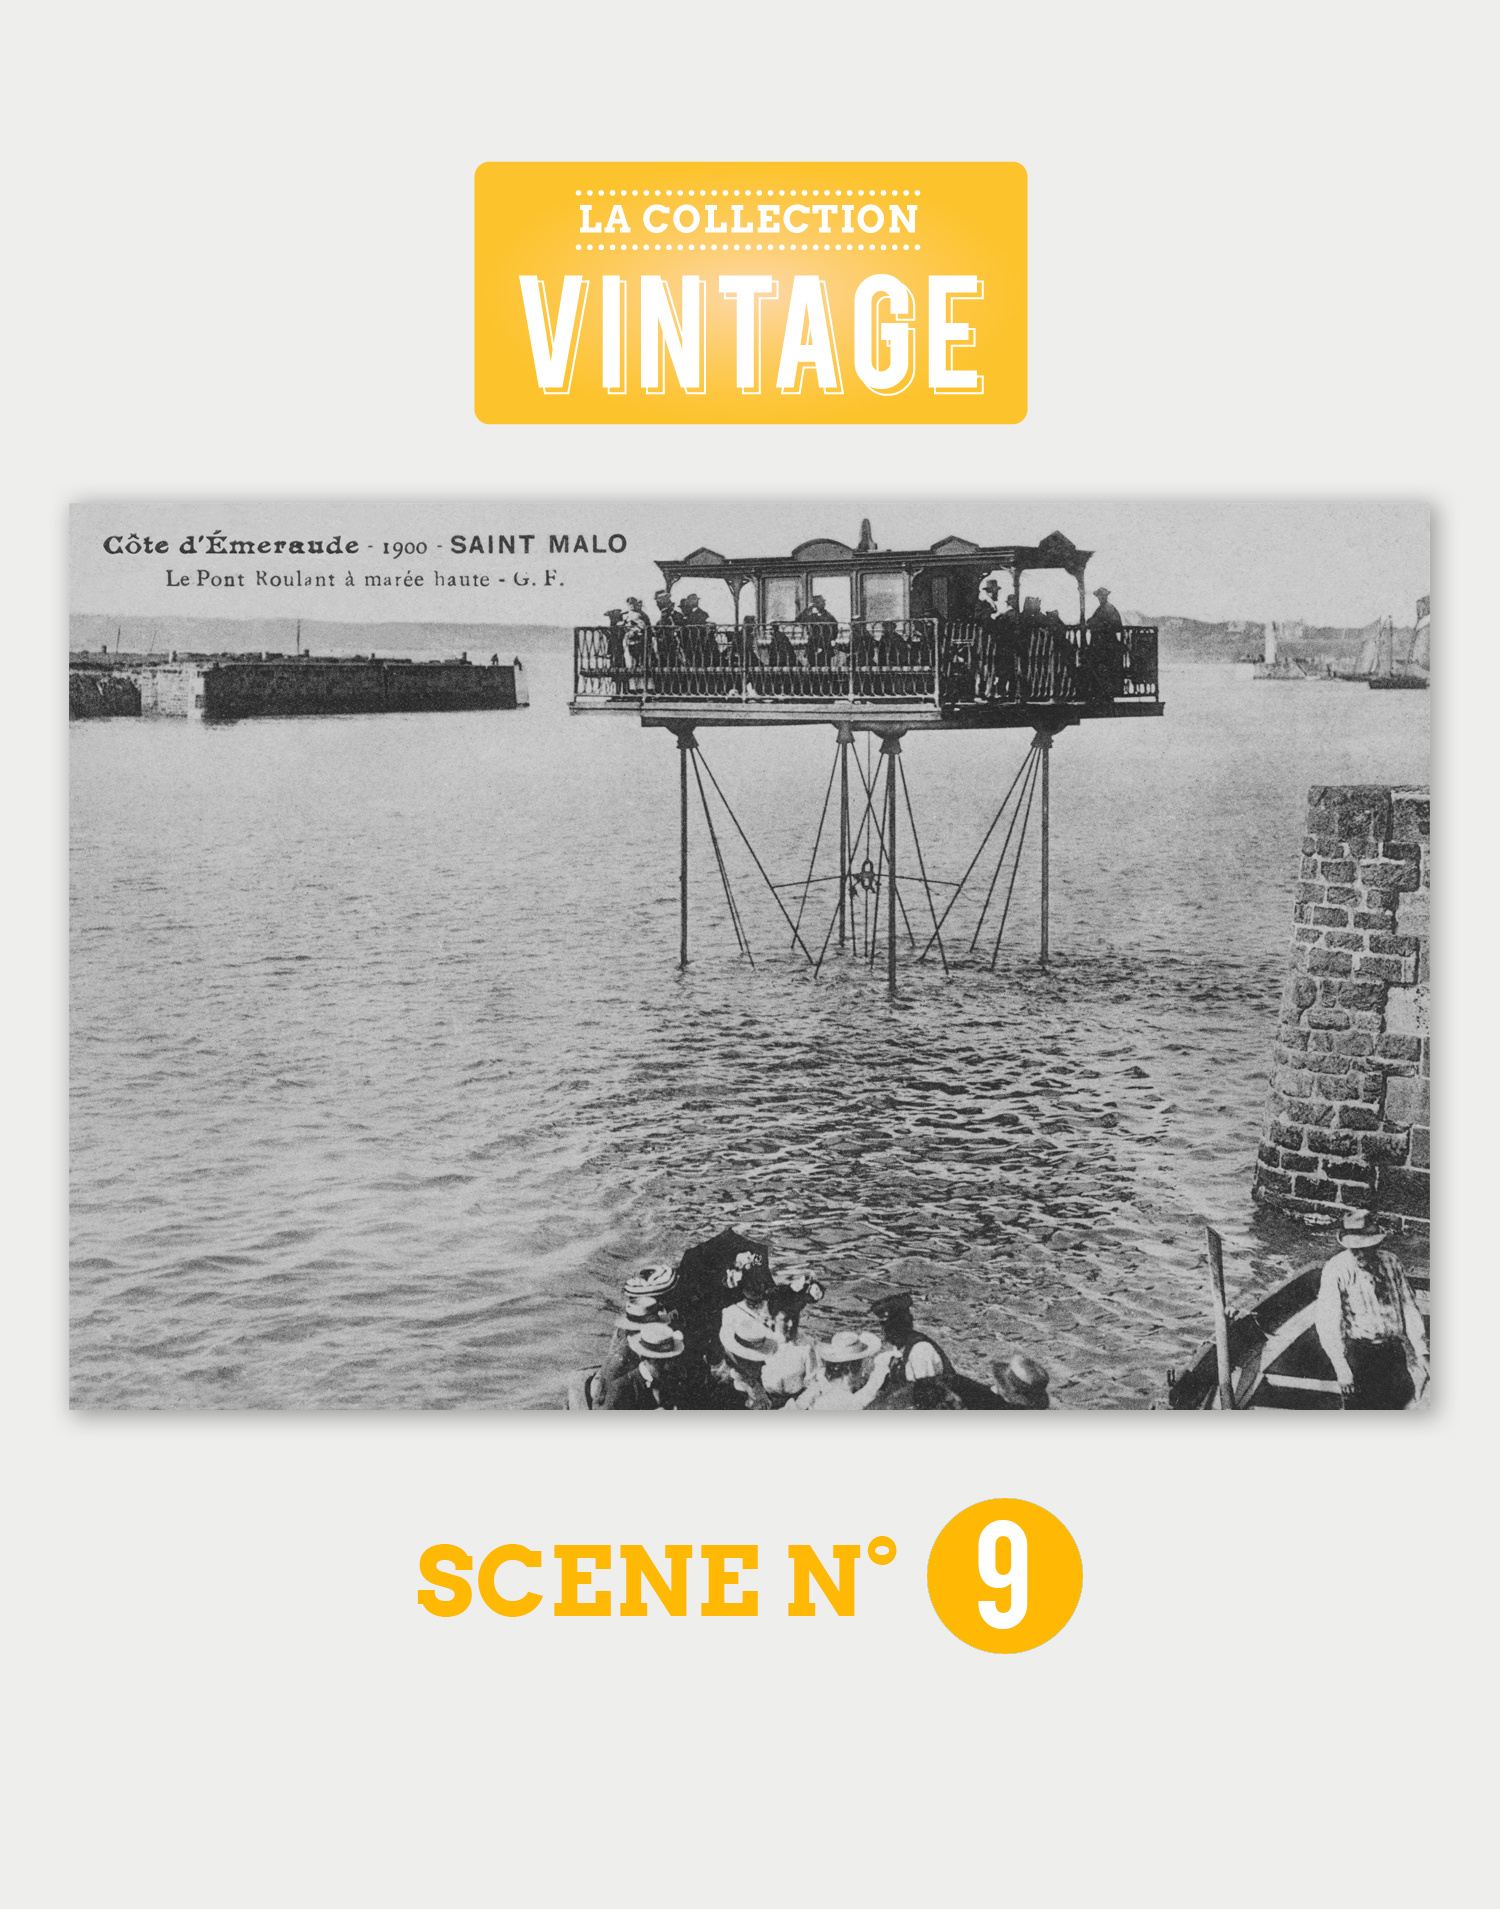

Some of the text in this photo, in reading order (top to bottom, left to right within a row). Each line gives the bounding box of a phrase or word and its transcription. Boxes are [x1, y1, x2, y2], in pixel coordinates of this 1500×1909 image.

[579, 204, 918, 234] LA COLLECTION
[518, 273, 985, 396] VINTAGE
[417, 1543, 759, 1617] SCENE
[977, 1519, 1028, 1630] 9
